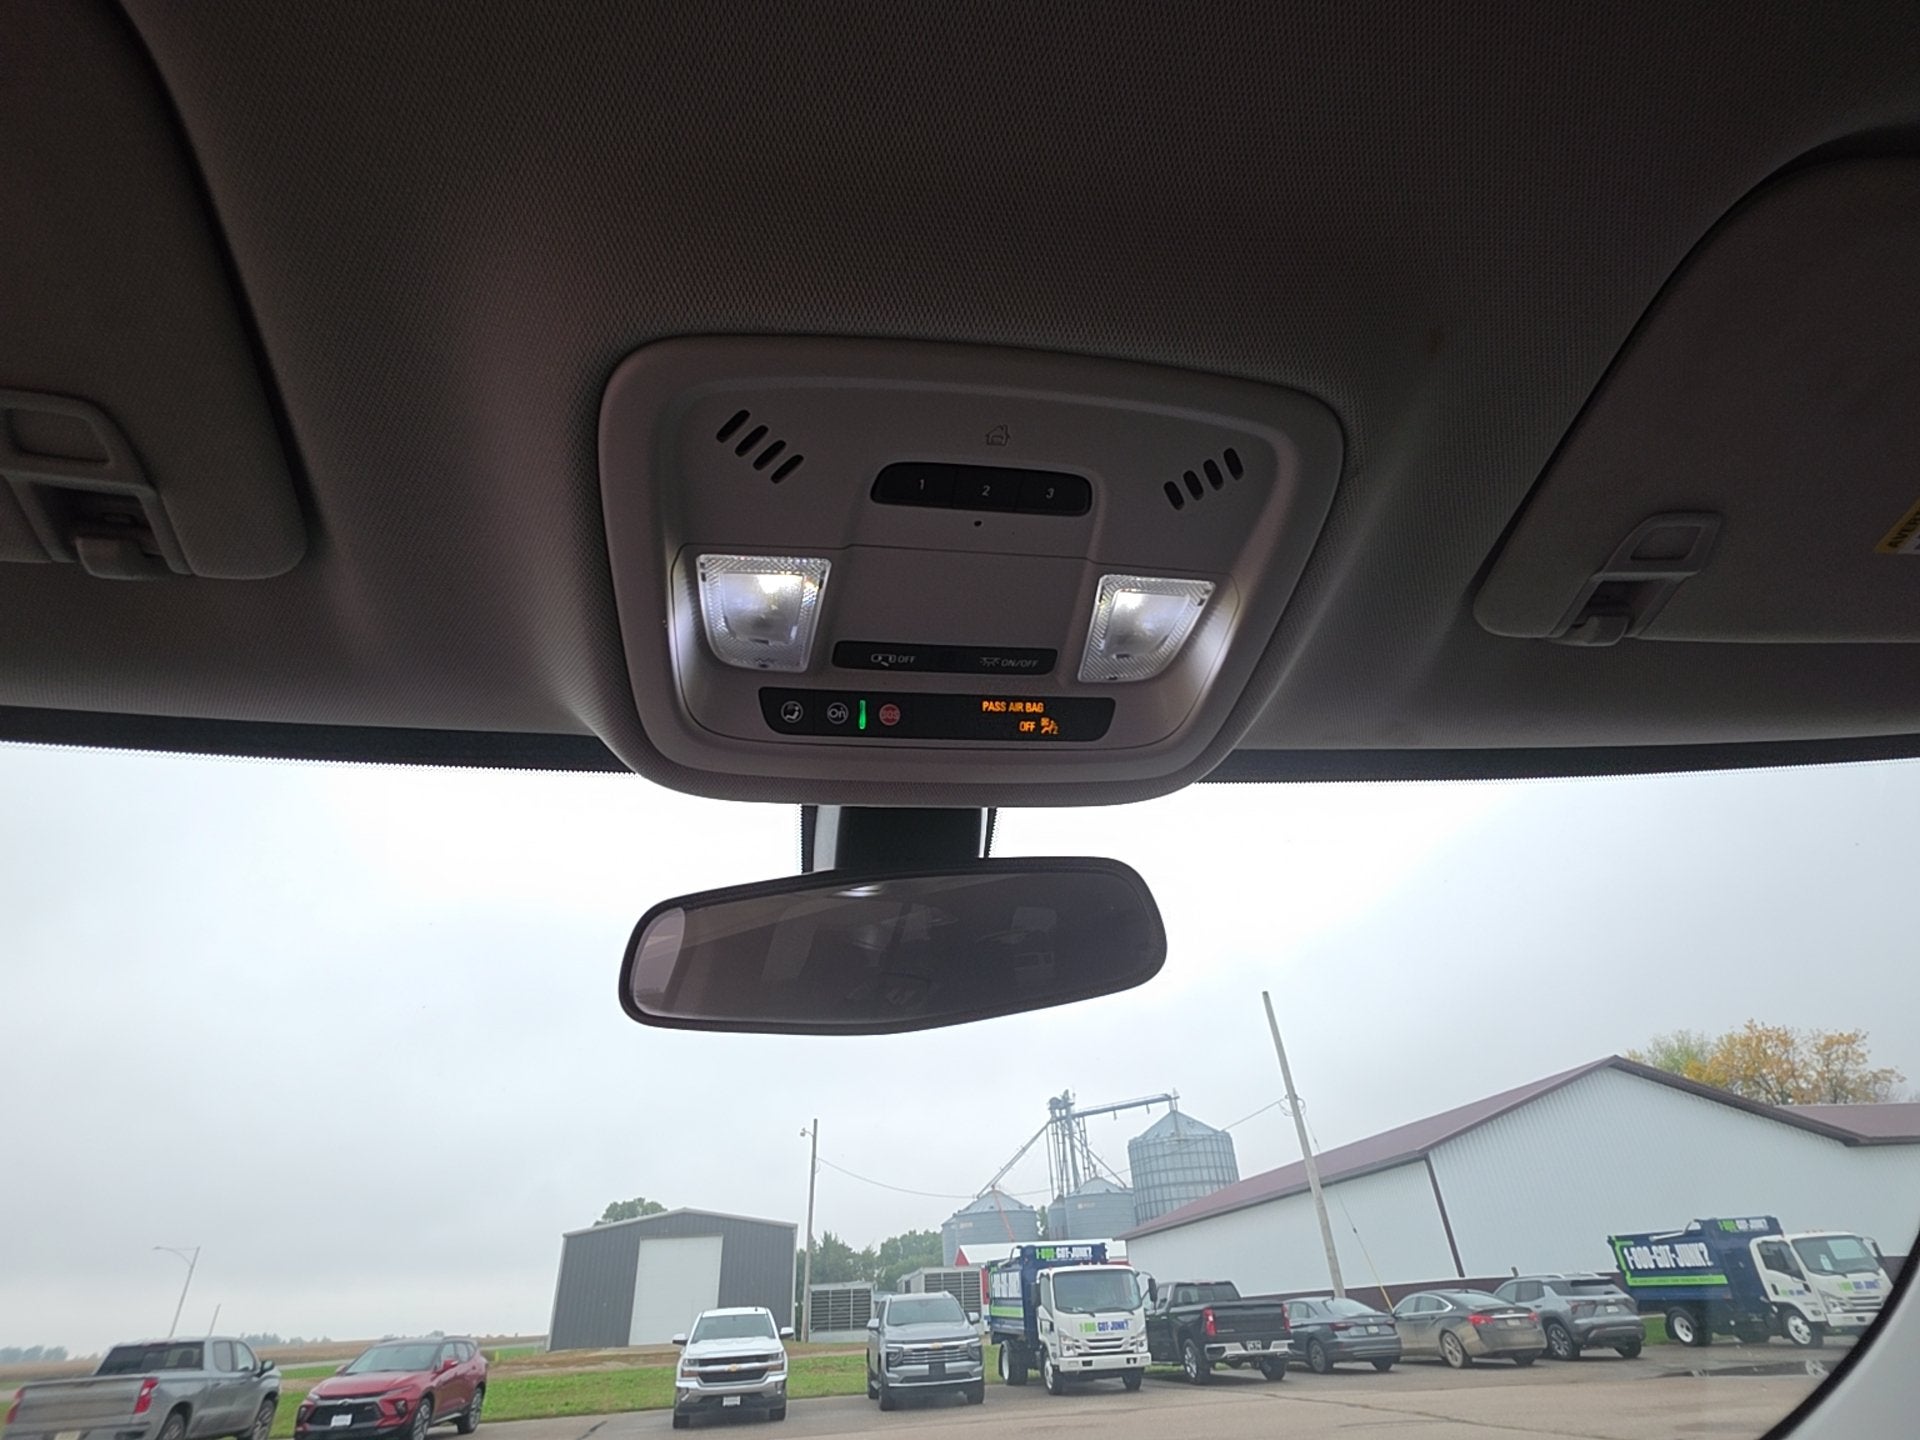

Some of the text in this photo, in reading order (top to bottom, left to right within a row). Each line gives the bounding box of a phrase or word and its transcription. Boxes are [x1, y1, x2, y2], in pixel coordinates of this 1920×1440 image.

[919, 478, 925, 490] 1
[982, 485, 991, 496] 2
[1046, 488, 1055, 499] 3
[898, 655, 916, 664] OFF
[1001, 659, 1039, 668] ON/OFF
[982, 700, 1045, 713] PASS AIR BAG
[1019, 720, 1036, 732] OFF
